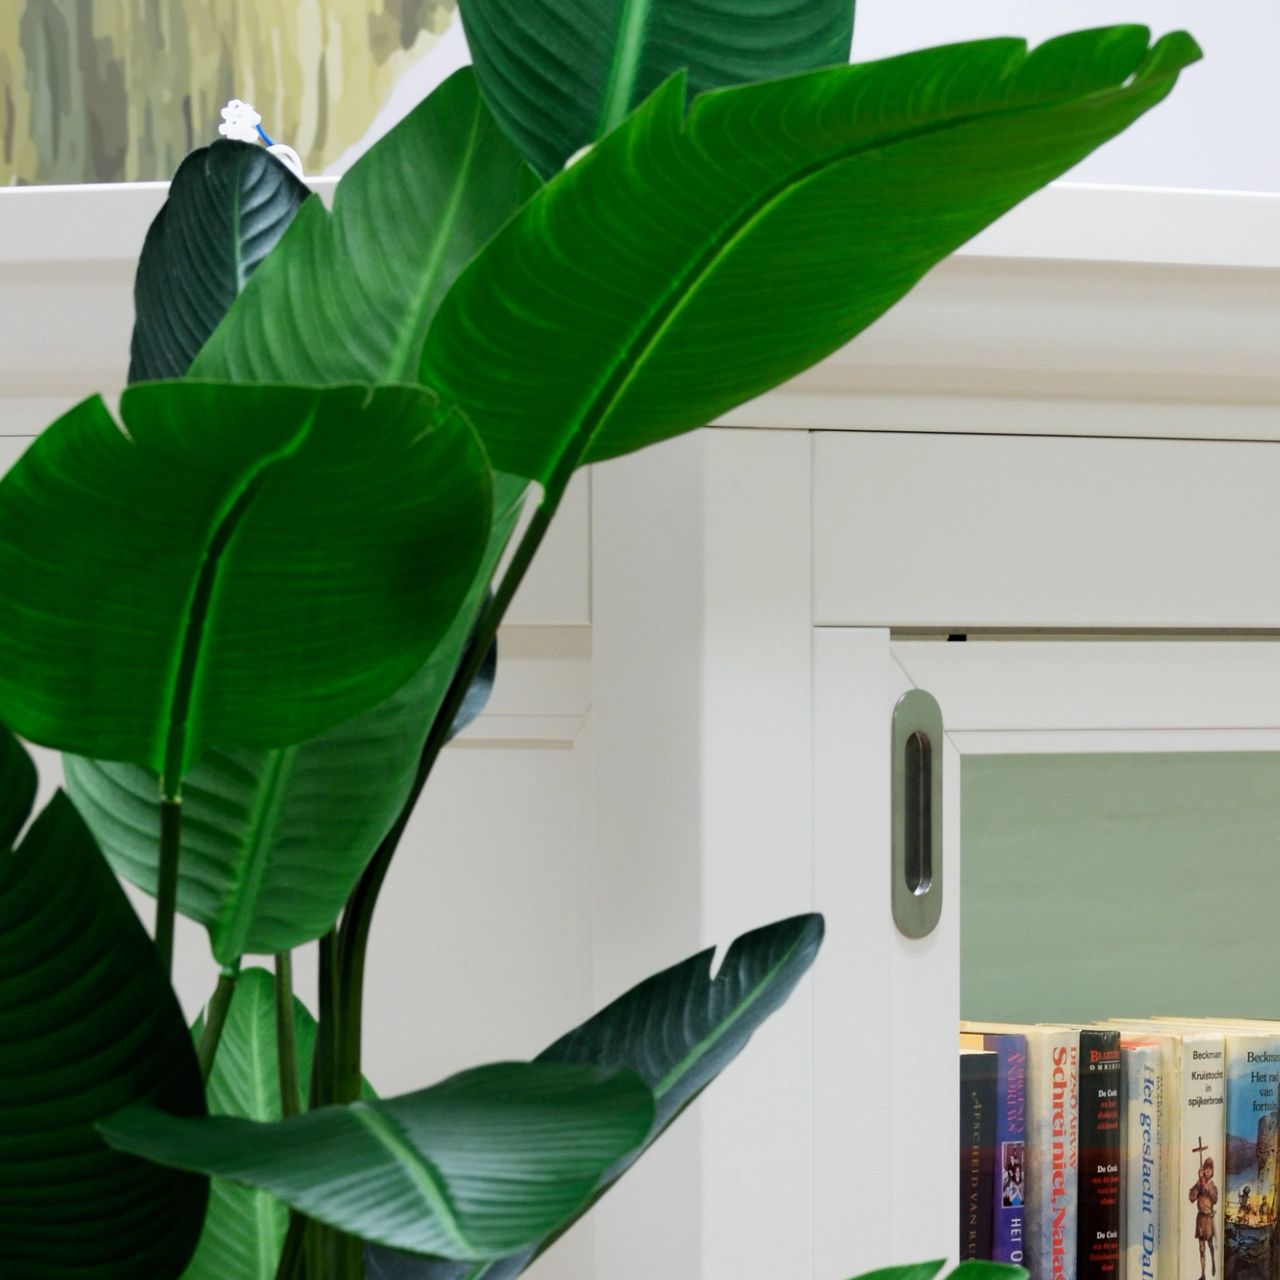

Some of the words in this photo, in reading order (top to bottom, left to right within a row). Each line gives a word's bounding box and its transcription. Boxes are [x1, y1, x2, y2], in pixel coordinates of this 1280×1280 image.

[1192, 1050, 1222, 1061] Beckman
[1247, 1052, 1280, 1063] Beckman
[1191, 1071, 1223, 1080] Kruistocht
[1251, 1072, 1267, 1083] Het
[1268, 1071, 1279, 1082] rad
[1142, 1064, 1155, 1105] Het
[1205, 1083, 1212, 1092] in
[1052, 1046, 1068, 1137] Schrei
[1259, 1088, 1273, 1097] van
[1188, 1096, 1224, 1107] spijkerbroek
[1252, 1100, 1279, 1112] fortuin
[1139, 1112, 1155, 1213] geslacht
[1050, 1141, 1067, 1203] niet,
[1010, 1217, 1021, 1242] HET
